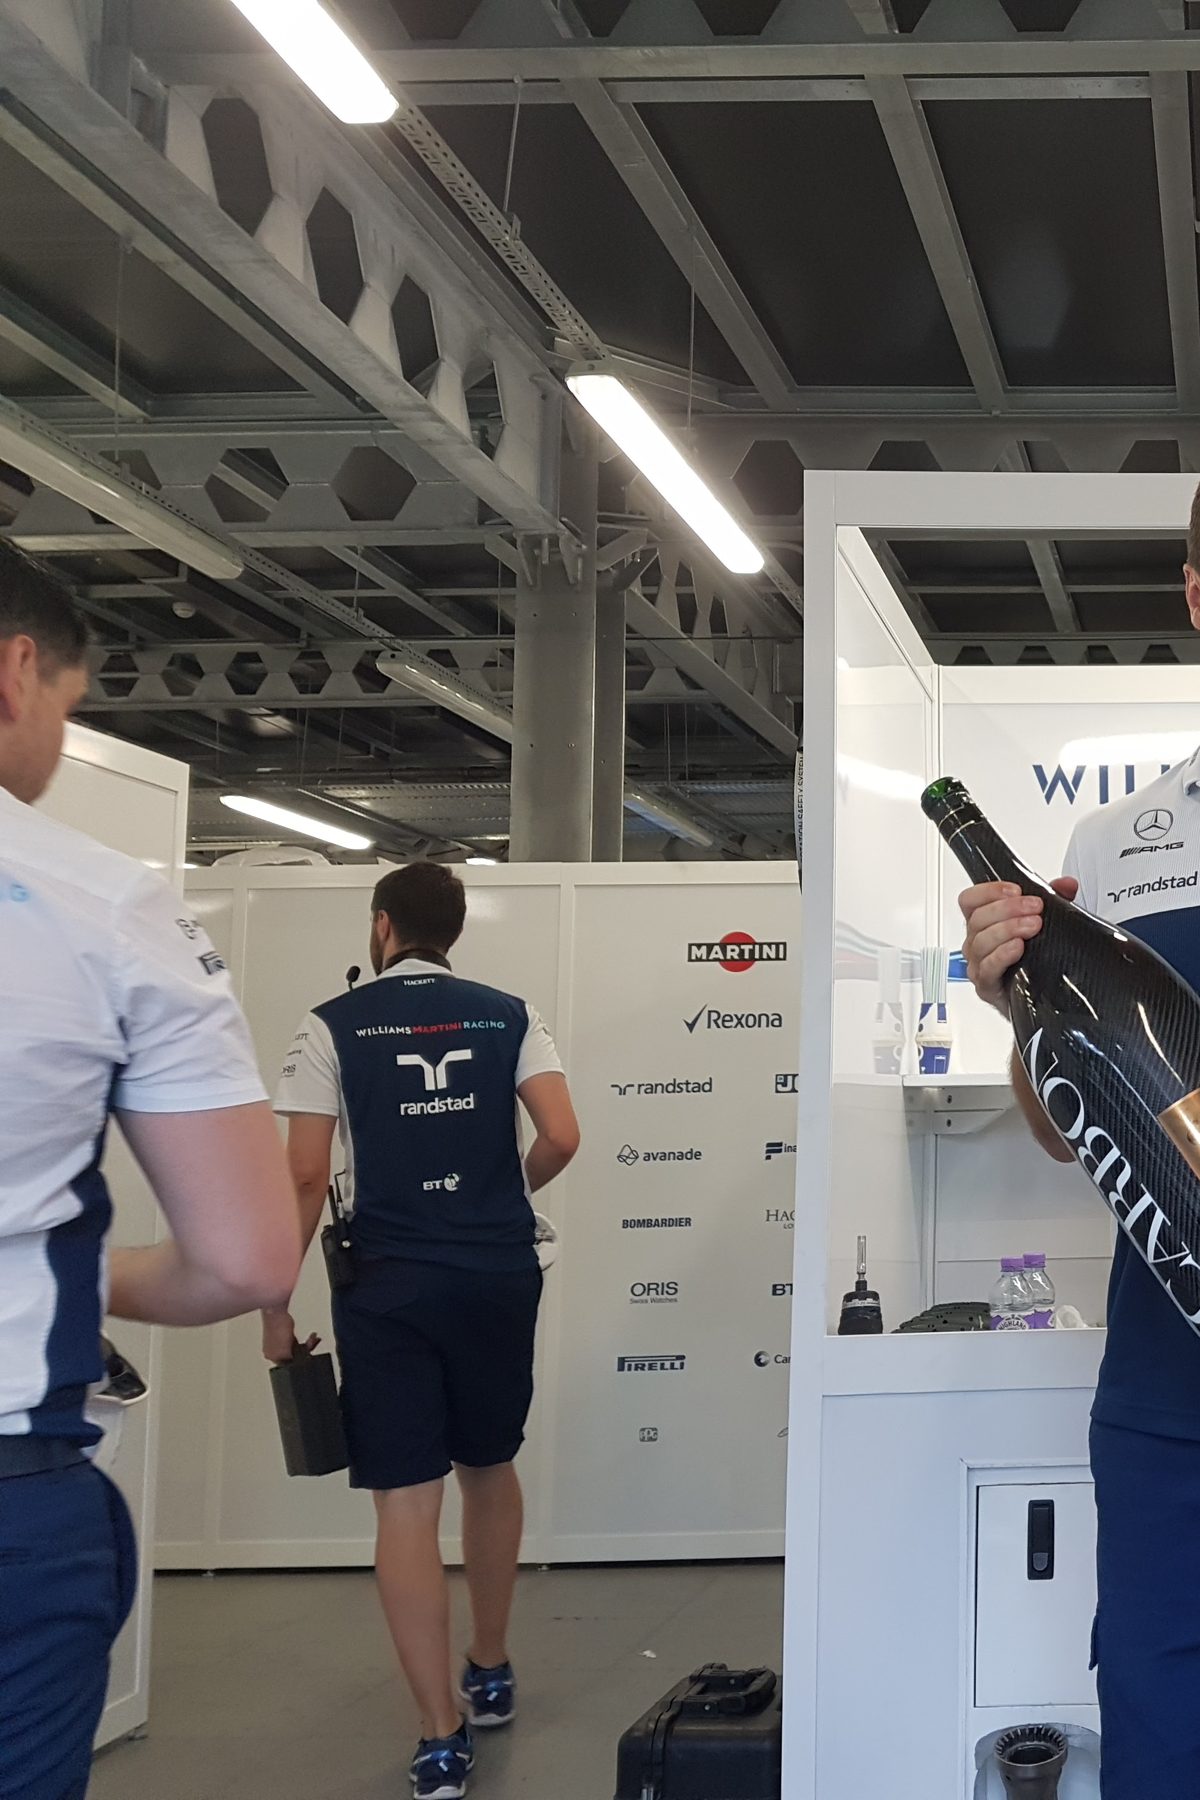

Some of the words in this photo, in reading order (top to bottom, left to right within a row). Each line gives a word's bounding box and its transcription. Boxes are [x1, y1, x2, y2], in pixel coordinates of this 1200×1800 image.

[1139, 841, 1184, 852] AMG
[1127, 871, 1199, 898] randstad
[691, 944, 784, 960] MARTINI
[404, 978, 435, 986] HACKETT
[707, 1009, 783, 1029] Rexona
[356, 1026, 412, 1038] WILLIAMS
[463, 1021, 506, 1030] RACING
[637, 1077, 713, 1094] randstad
[400, 1093, 474, 1115] randstad
[643, 1148, 702, 1162] avanade
[423, 1180, 443, 1191] BT
[622, 1217, 692, 1229] BOMBARDIER
[630, 1281, 678, 1297] ORIS
[617, 1355, 686, 1372] PIRELLI
